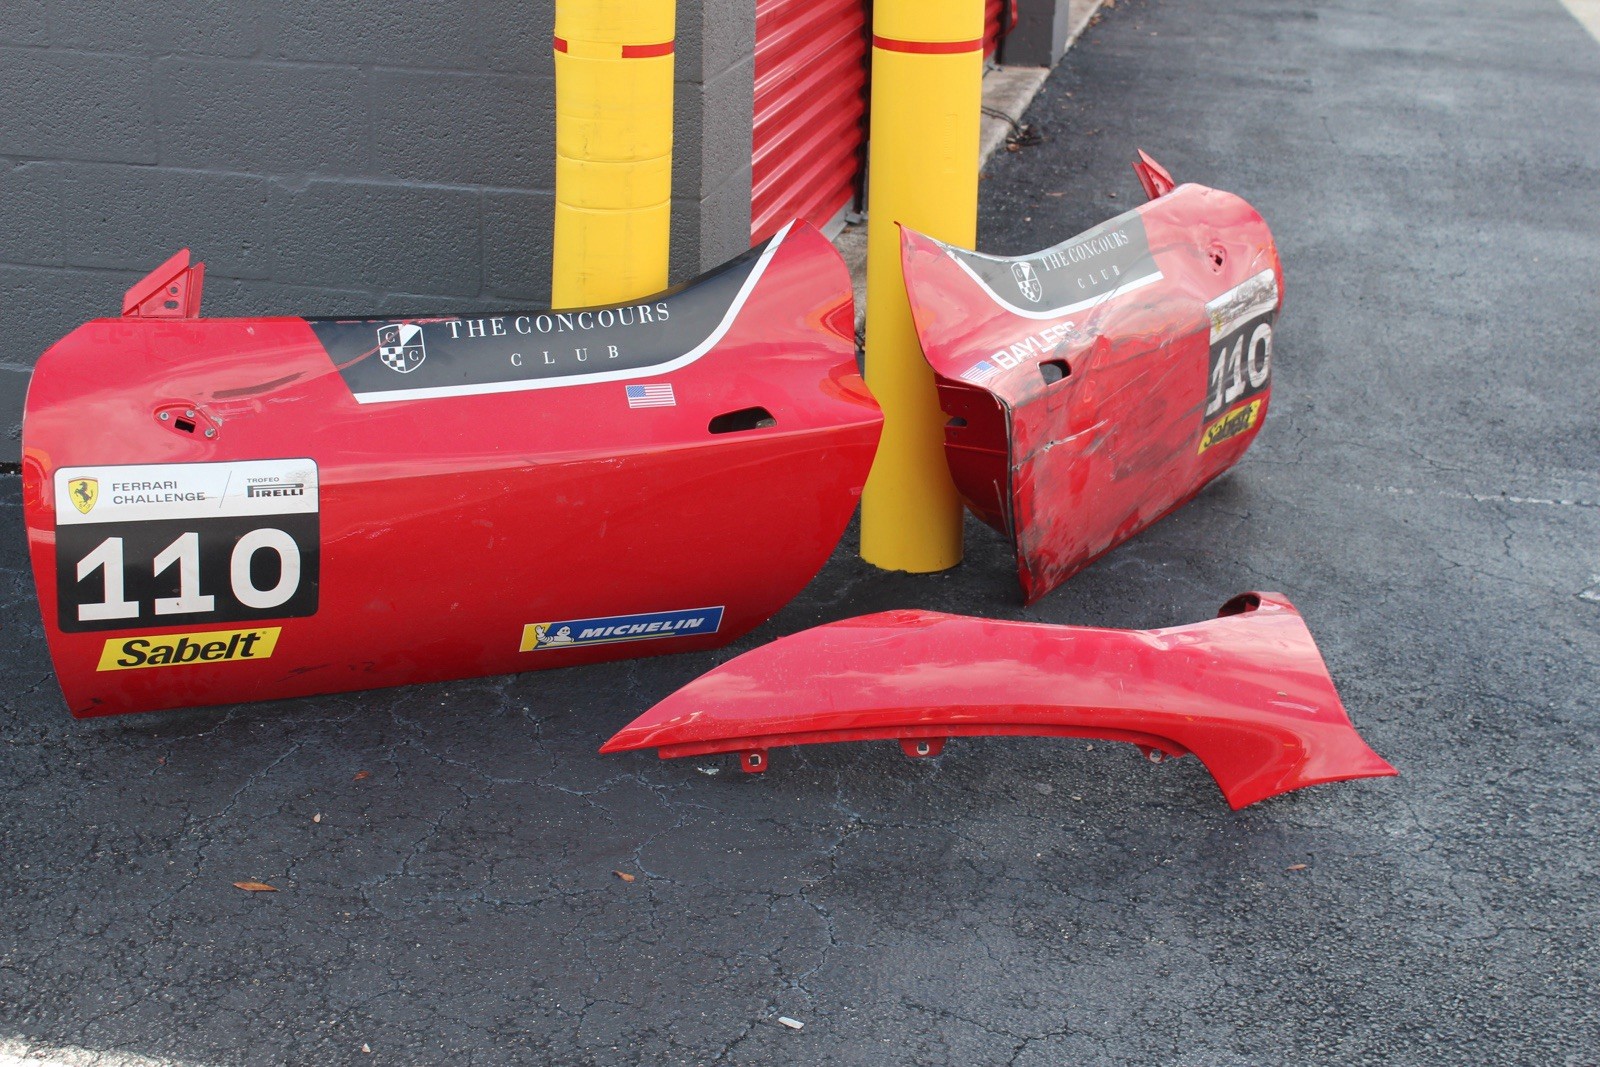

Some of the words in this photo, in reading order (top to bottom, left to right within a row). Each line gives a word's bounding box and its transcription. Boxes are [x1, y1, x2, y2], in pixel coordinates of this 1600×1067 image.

[1039, 250, 1070, 272] THE
[1068, 229, 1129, 263] CONCOURS
[1077, 264, 1121, 289] CLUB
[445, 316, 507, 340] THE
[515, 302, 671, 336] CONCOURS
[385, 331, 396, 344] C
[409, 349, 420, 363] C
[510, 345, 620, 367] CLUB
[1205, 322, 1272, 418] 110
[112, 481, 178, 493] FERRARI
[113, 491, 206, 505] CHALLENGE
[246, 483, 305, 499] PIRELLI
[76, 527, 301, 622] 110
[578, 617, 706, 640] MICHELIN
[117, 631, 262, 668] Sabelt
